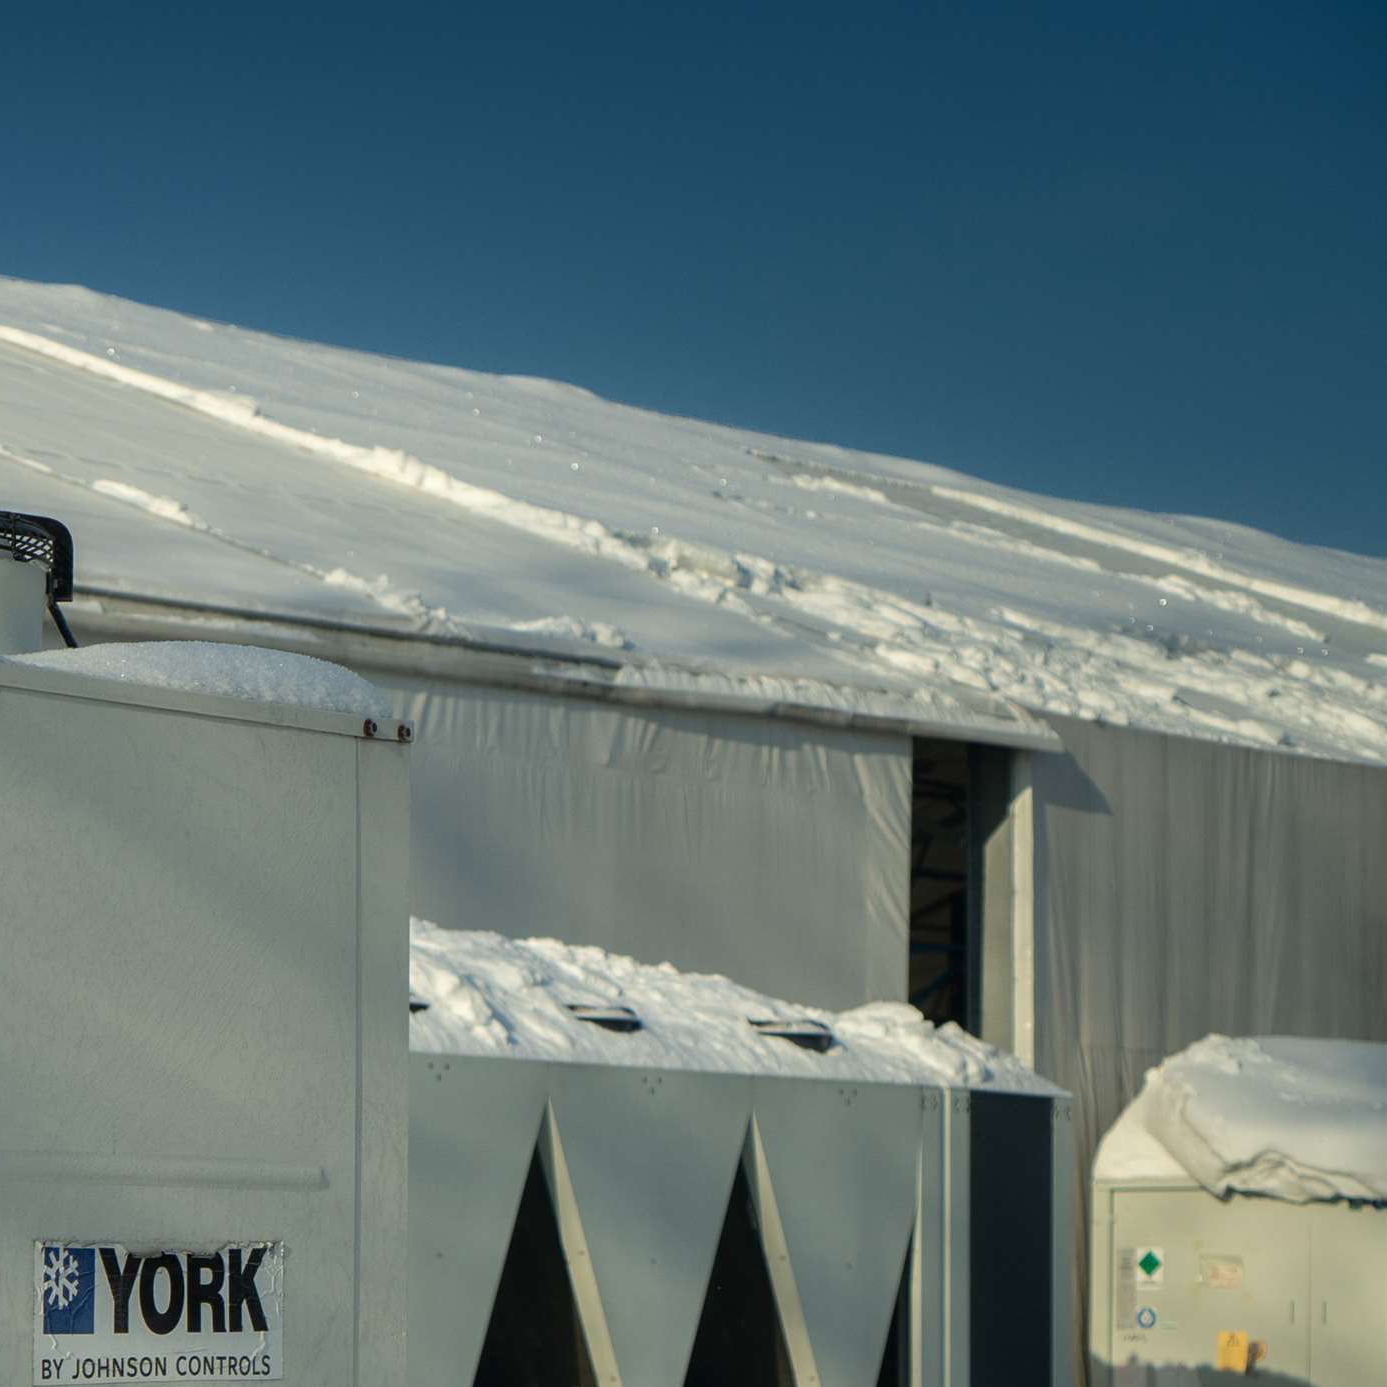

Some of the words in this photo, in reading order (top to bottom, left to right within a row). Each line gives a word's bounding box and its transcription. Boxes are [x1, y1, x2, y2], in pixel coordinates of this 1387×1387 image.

[97, 1247, 270, 1336] YORK
[41, 1358, 64, 1380] BY
[72, 1356, 168, 1379] JOHNSON
[176, 1354, 271, 1376] CONTROLS
